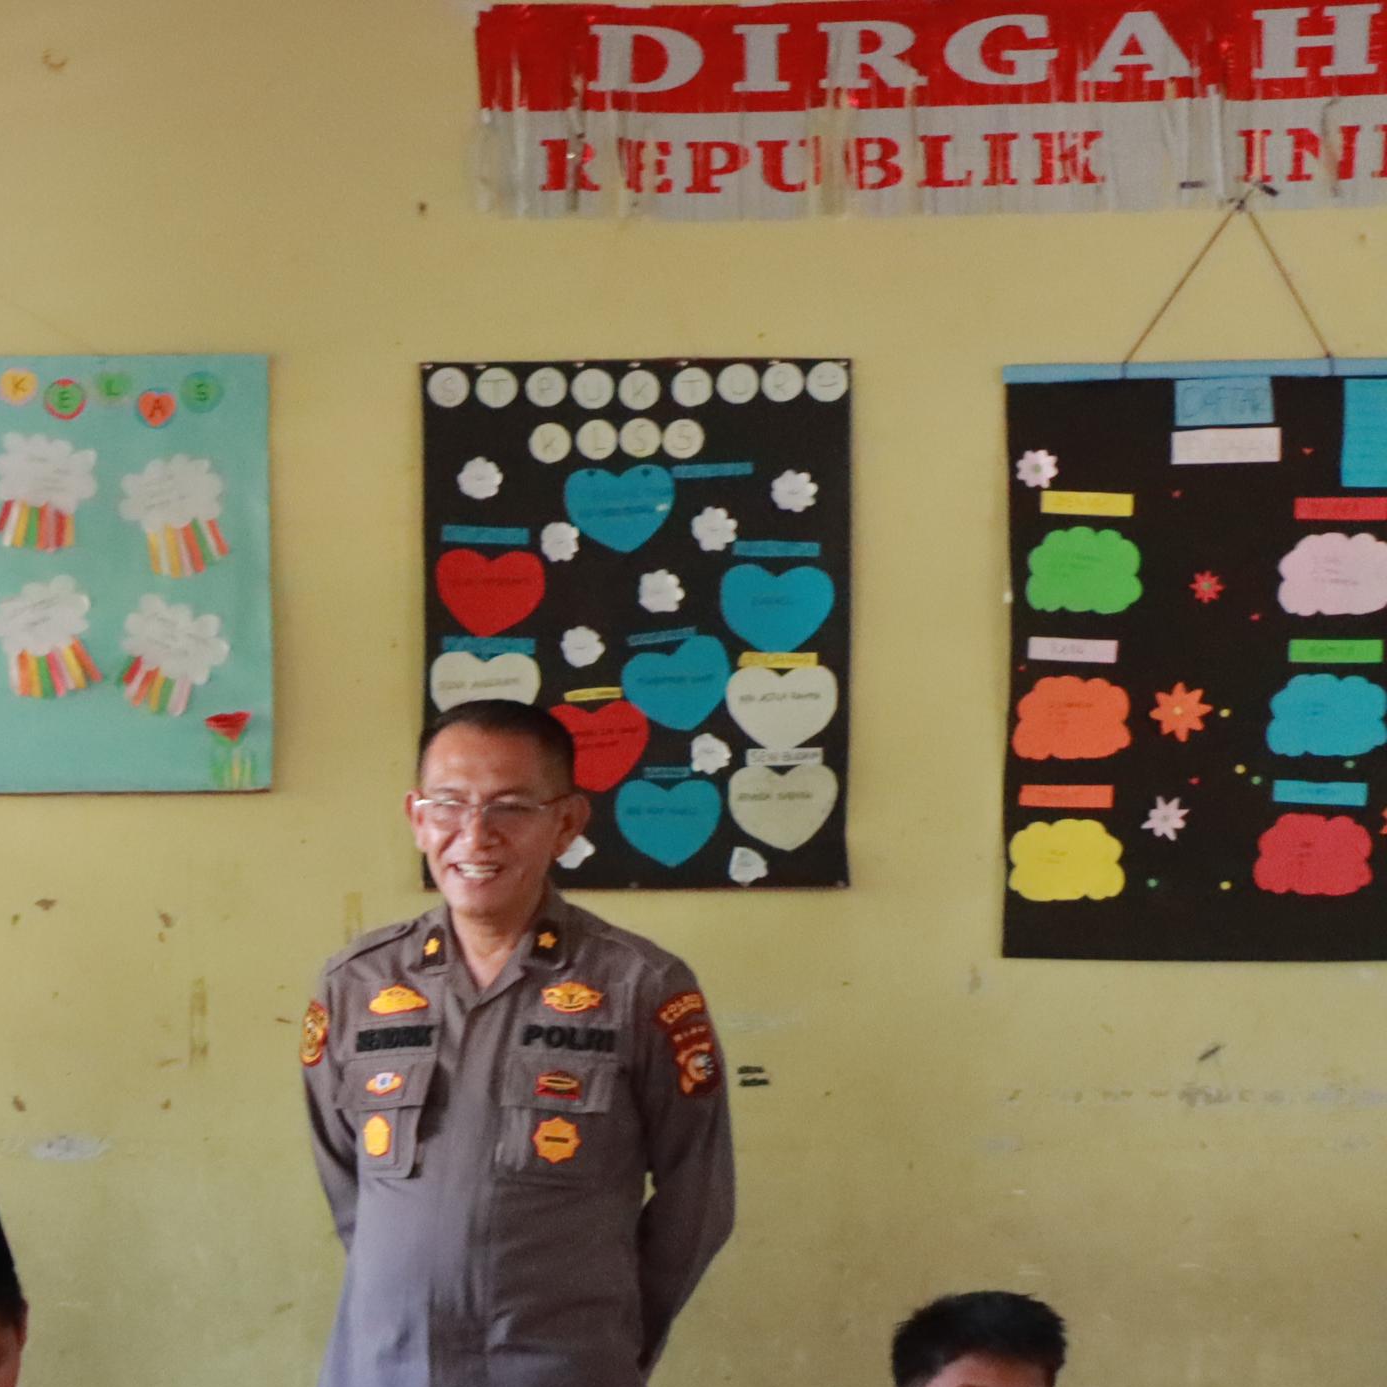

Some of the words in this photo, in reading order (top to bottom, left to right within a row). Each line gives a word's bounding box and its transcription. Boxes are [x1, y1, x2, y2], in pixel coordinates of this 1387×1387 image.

[539, 128, 1106, 193] REPUBLIK
[1236, 124, 1387, 183] IN
[522, 1024, 615, 1053] POLRI
